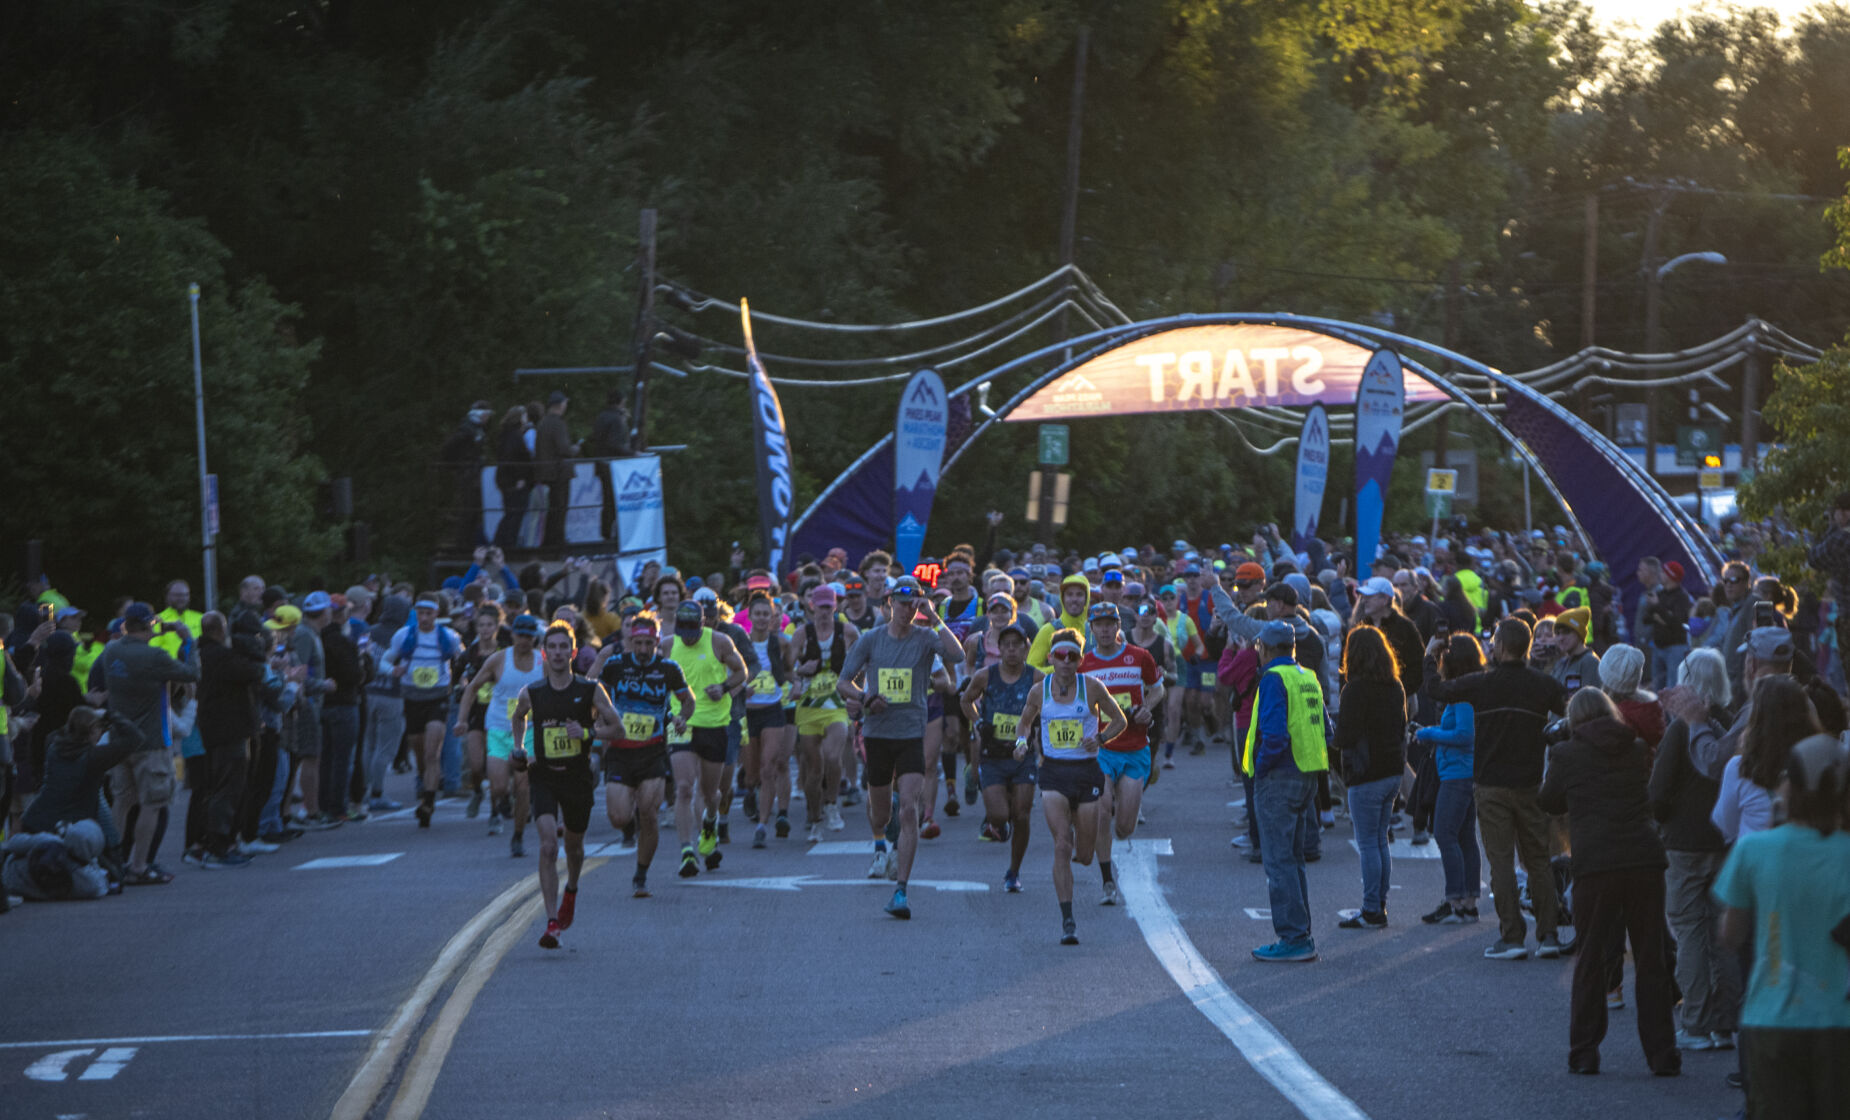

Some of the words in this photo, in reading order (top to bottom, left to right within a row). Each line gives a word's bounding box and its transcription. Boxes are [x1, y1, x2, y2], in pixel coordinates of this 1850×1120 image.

[617, 680, 666, 697] NOAH
[887, 679, 904, 690] 110
[629, 723, 647, 735] 124
[1000, 724, 1016, 734] 104
[1057, 730, 1076, 742] 102
[553, 737, 572, 750] 101
